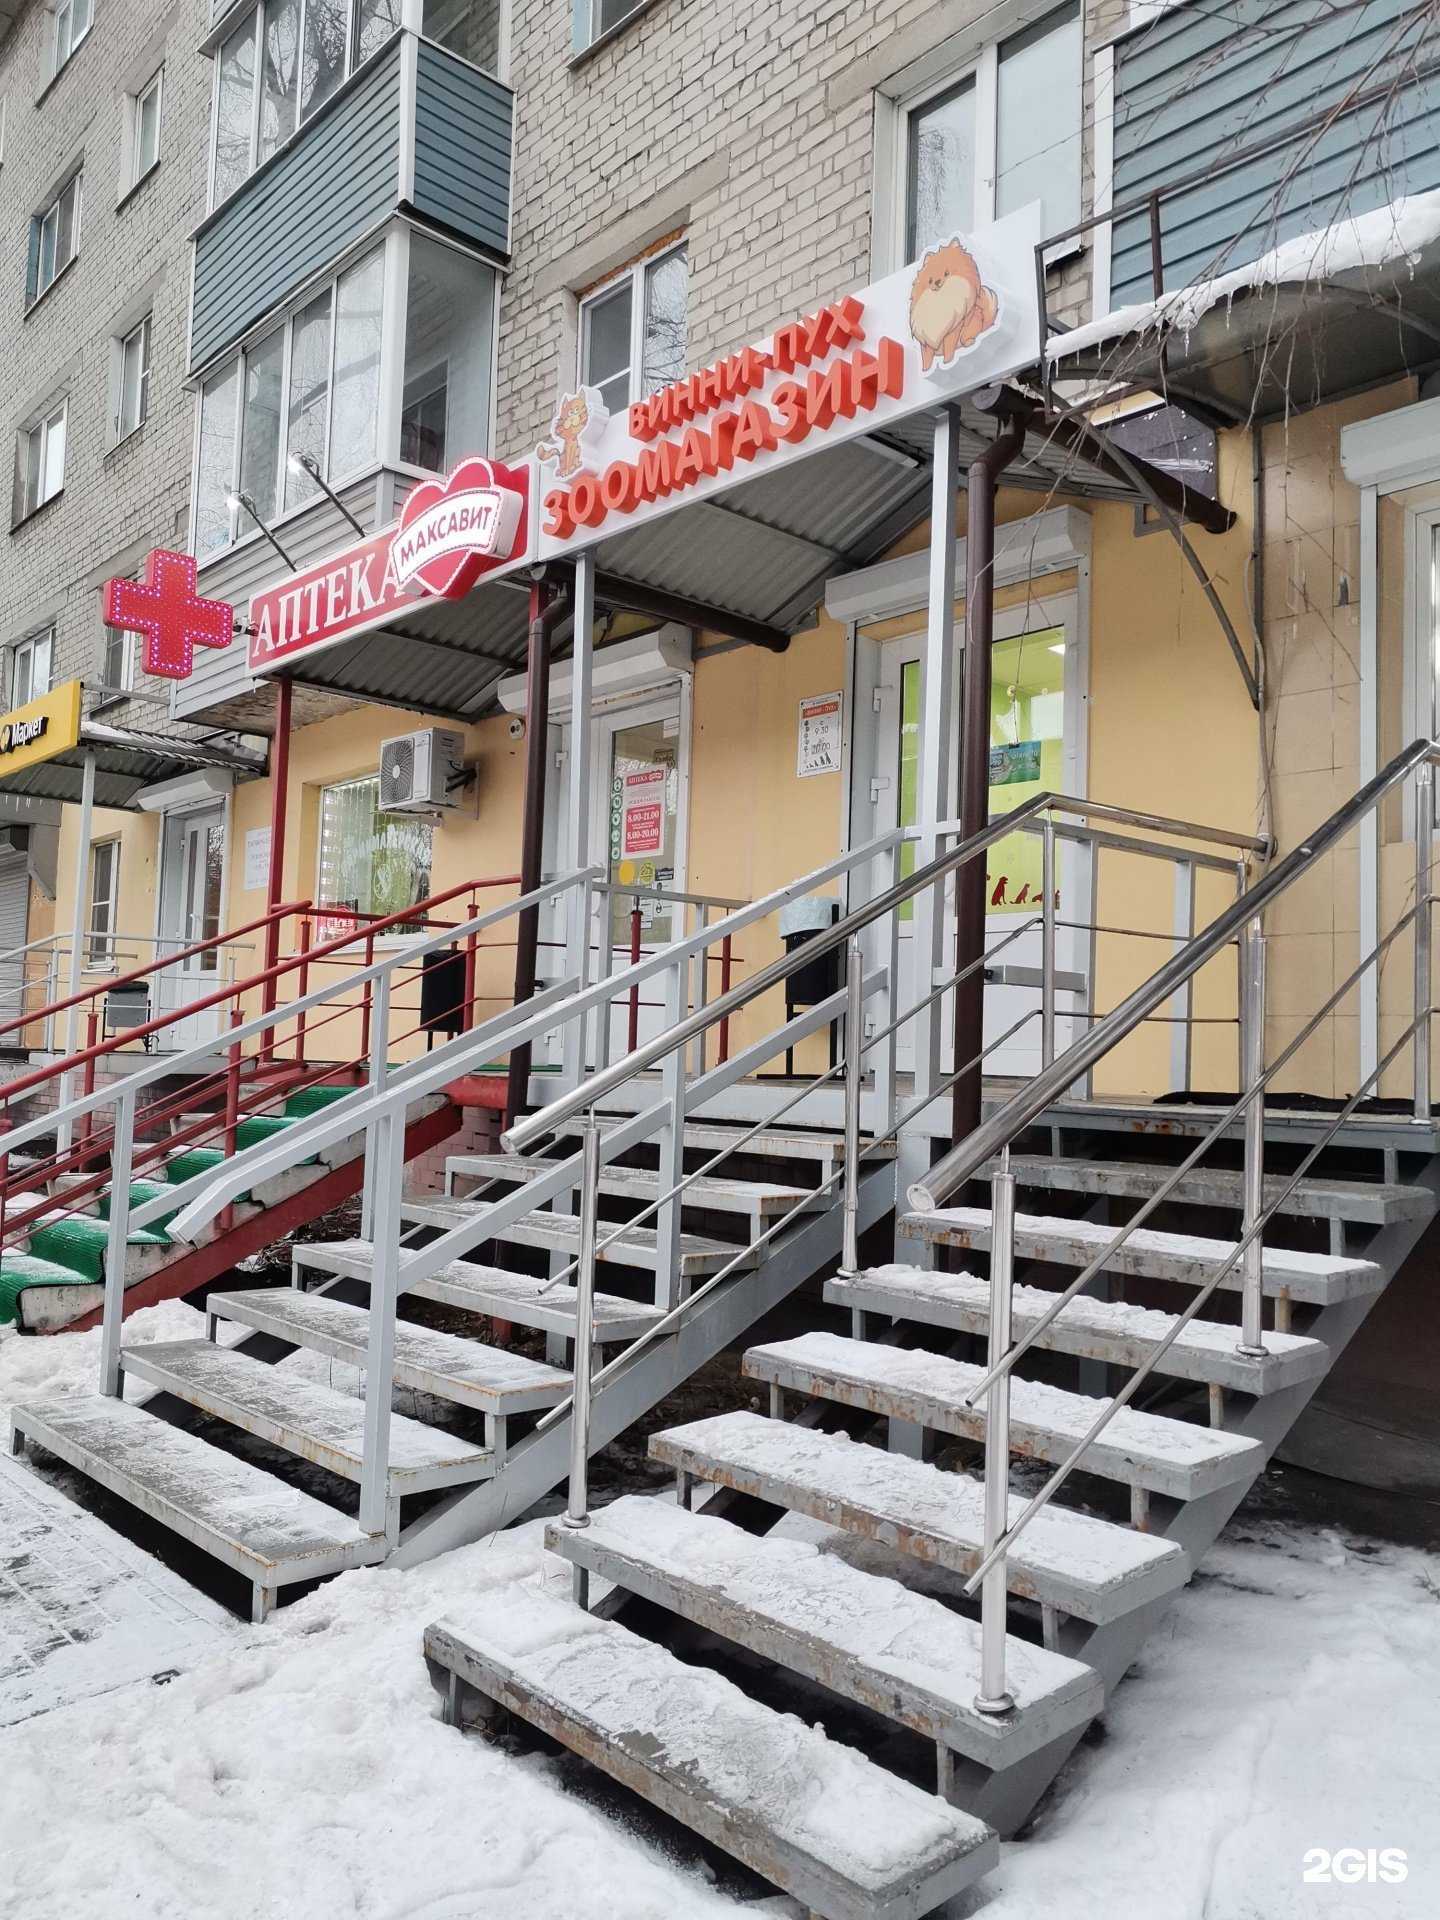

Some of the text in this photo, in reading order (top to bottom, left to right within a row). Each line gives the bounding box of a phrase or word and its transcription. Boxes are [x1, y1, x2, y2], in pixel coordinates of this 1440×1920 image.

[629, 295, 866, 443] ВИННИ-ПУХ
[542, 336, 904, 540] ЗООМАГАЗИН
[400, 506, 492, 568] МАКСАВИТ
[251, 553, 404, 658] АПТЕКА
[11, 715, 44, 748] Маркет
